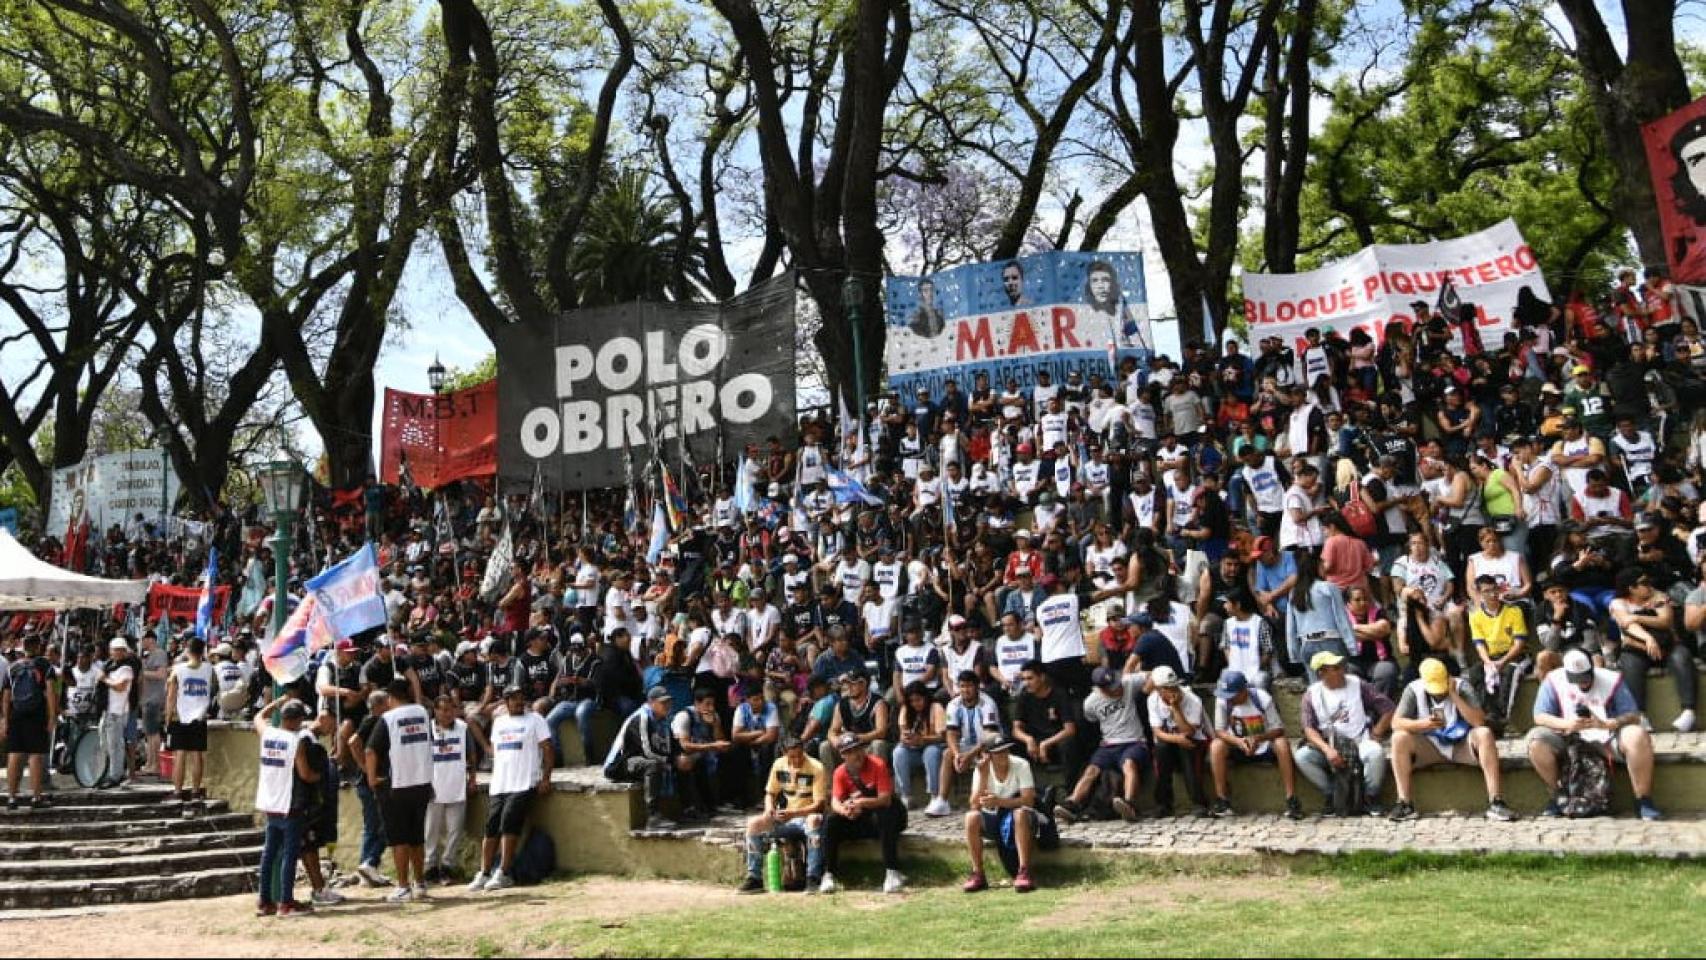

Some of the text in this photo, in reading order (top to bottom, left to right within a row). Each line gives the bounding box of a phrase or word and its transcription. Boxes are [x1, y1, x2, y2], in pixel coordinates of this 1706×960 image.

[1243, 245, 1537, 324] BLOQUE PIQUETERO
[555, 323, 727, 398] POLO
[956, 306, 1092, 361] M.A.R.
[520, 373, 772, 459] OBRERO
[1580, 396, 1604, 416] 12
